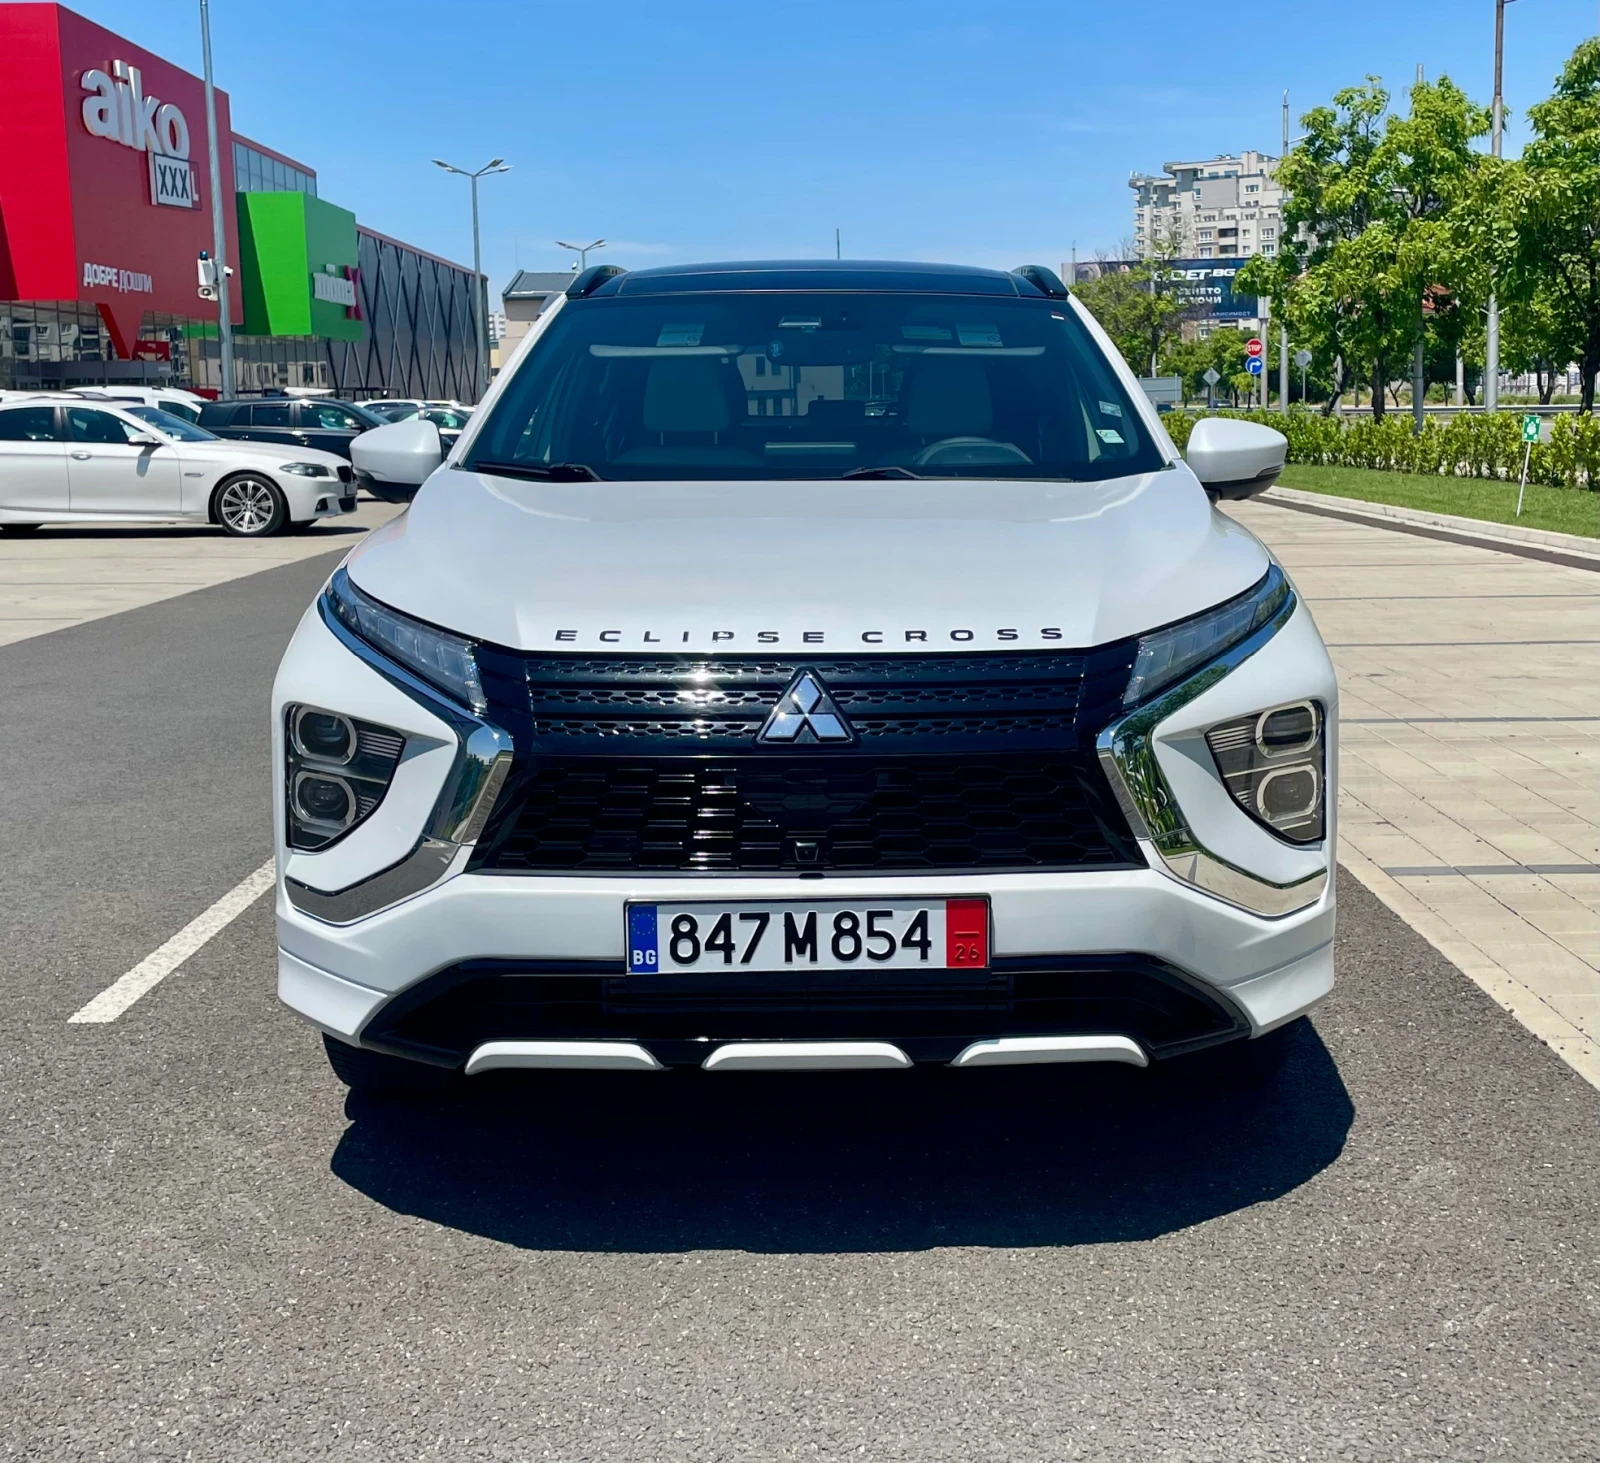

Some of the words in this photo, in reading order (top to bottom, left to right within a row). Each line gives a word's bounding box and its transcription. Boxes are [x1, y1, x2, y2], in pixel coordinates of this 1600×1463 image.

[81, 59, 190, 162] aiko
[83, 262, 118, 288] ДОБРЕ
[118, 269, 153, 294] ДОШЛИ
[1247, 344, 1262, 352] STOP
[554, 628, 826, 644] ECLIPSE
[861, 627, 1064, 643] CROSS
[633, 949, 656, 965] BG
[668, 911, 771, 965] 847
[783, 910, 818, 964] M
[831, 909, 933, 963] 854
[954, 942, 980, 960] 26
